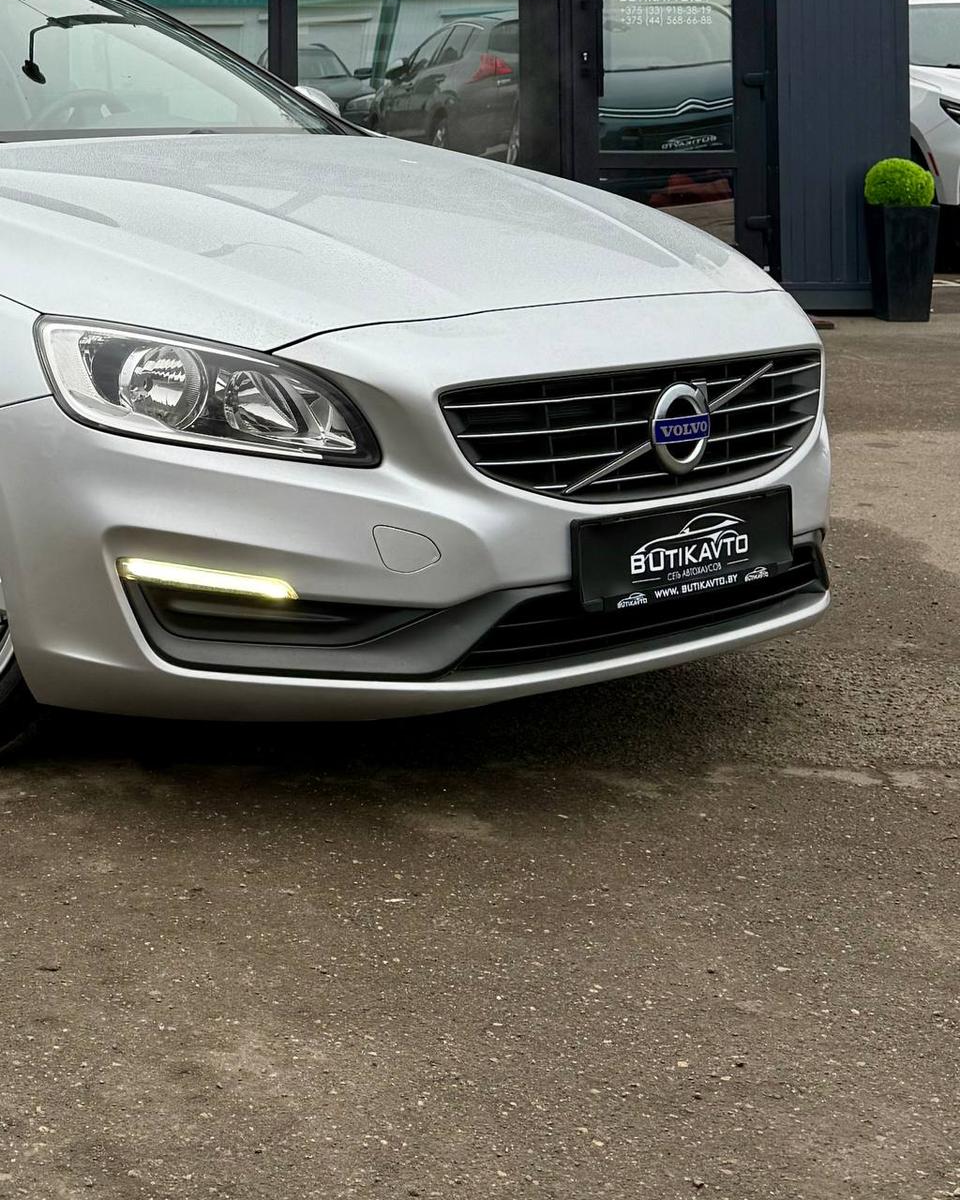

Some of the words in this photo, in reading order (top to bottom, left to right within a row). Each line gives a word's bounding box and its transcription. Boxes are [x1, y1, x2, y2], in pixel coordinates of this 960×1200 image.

[620, 5, 643, 15] +375
[620, 15, 643, 25] +375
[660, 420, 708, 438] VOLVO
[630, 534, 749, 575] BUTIKAVTO
